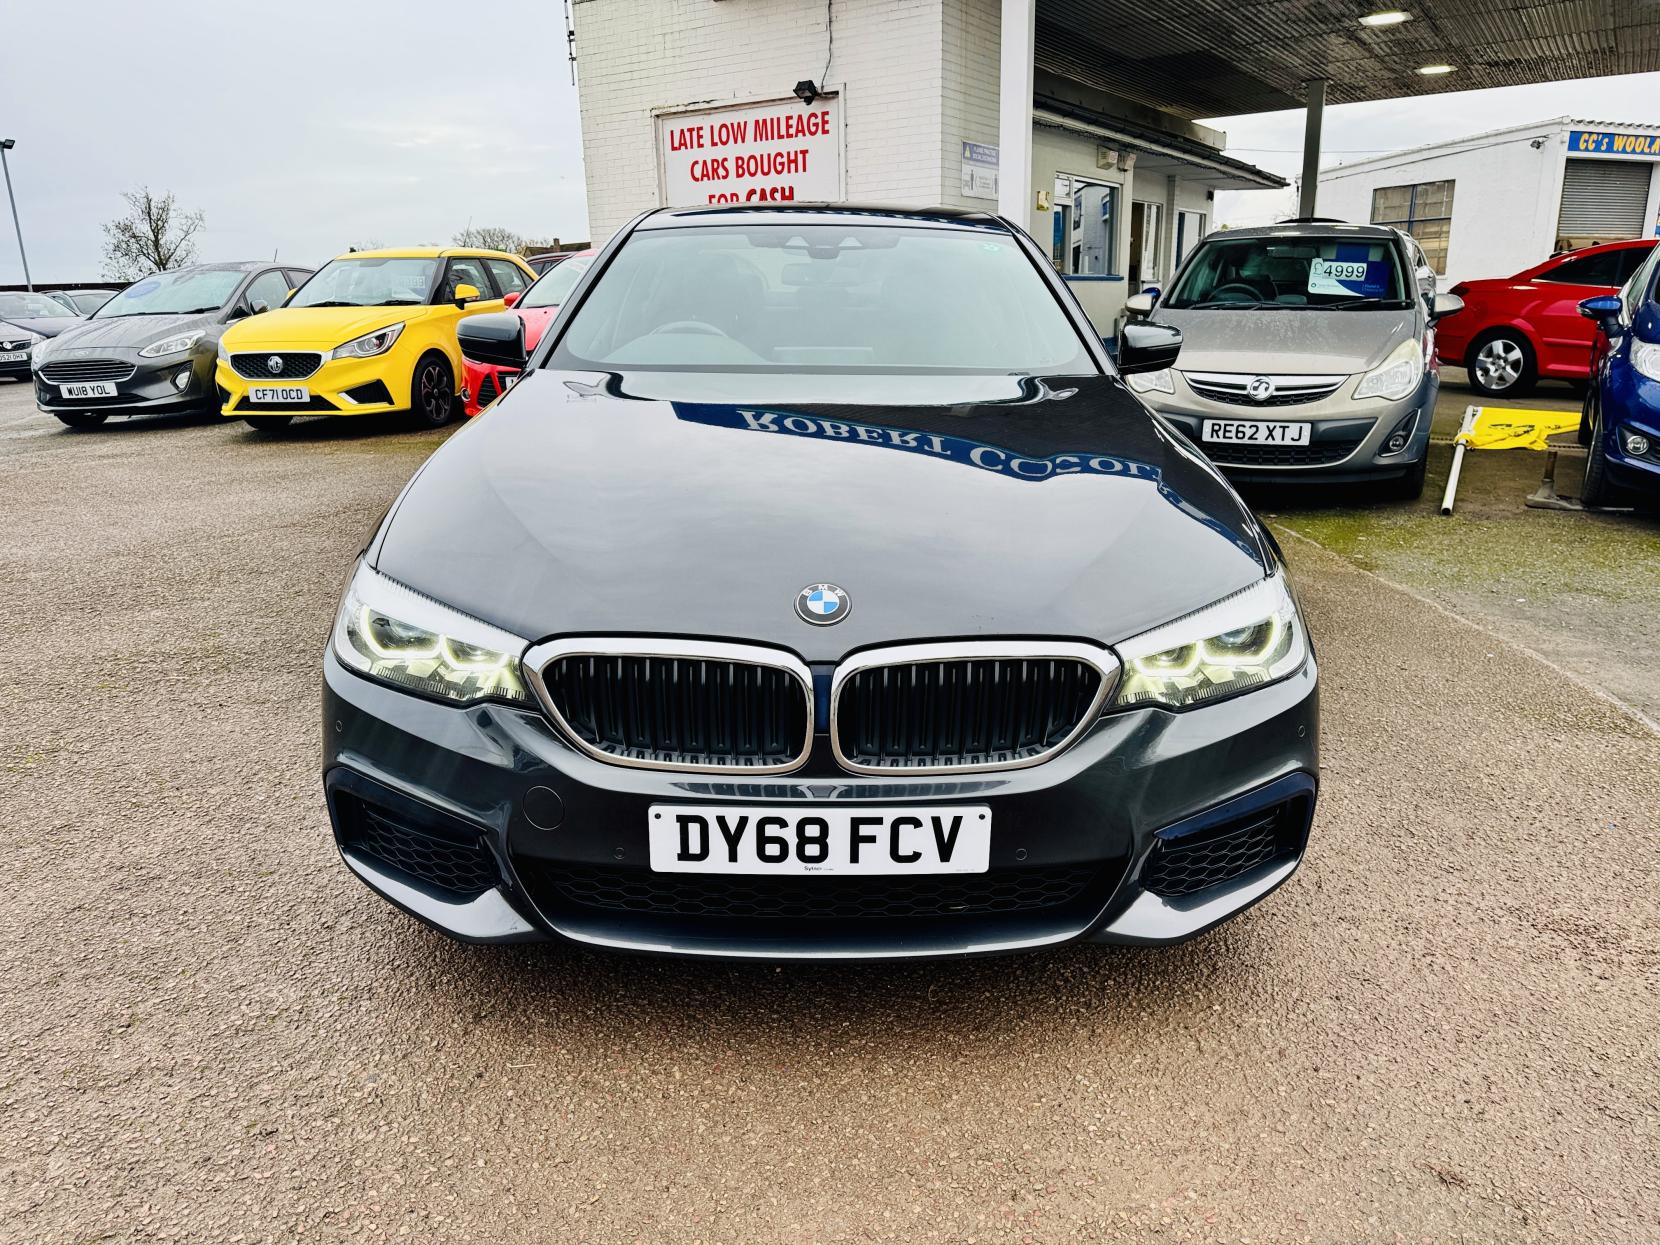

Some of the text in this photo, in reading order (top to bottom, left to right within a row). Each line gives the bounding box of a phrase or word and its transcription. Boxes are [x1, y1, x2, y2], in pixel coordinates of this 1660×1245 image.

[670, 111, 830, 151] LATE LOW MILEAGE
[1579, 133, 1609, 151] CC's
[690, 149, 809, 182] CARS BOUGHT
[1313, 262, 1365, 278] £4999
[66, 384, 111, 397] WU18 YOL
[255, 389, 303, 400] CF71 OCD
[1210, 422, 1303, 442] RE62 XTJ
[675, 814, 964, 864] DY68 FCV
